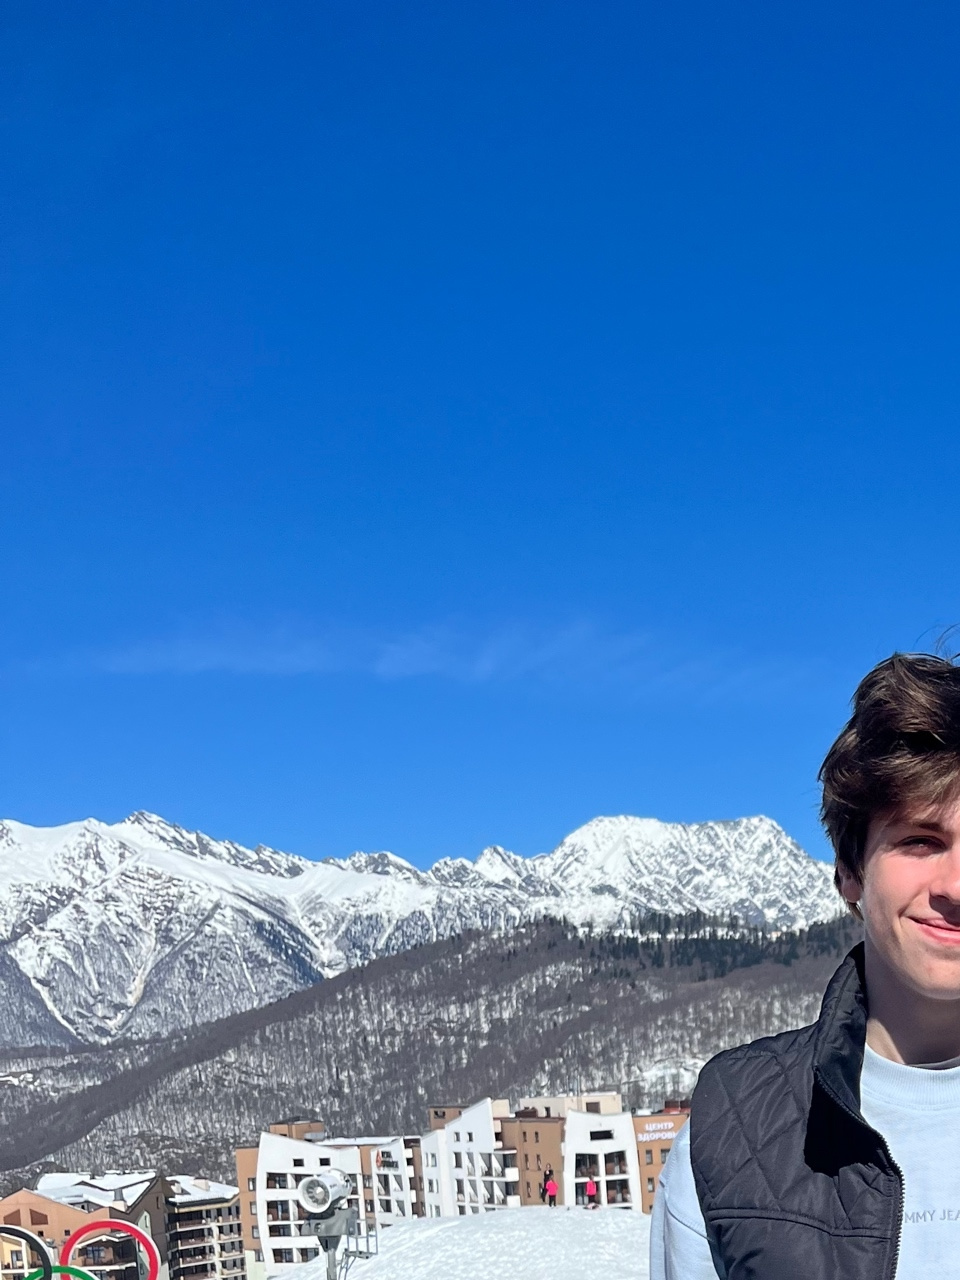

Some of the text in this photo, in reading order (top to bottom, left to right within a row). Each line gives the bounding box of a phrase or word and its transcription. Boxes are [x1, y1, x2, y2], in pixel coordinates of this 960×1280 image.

[645, 1121, 674, 1131] ЦЕНТР
[637, 1131, 677, 1142] ЗДОРОВЬ
[904, 1210, 936, 1224] MMY
